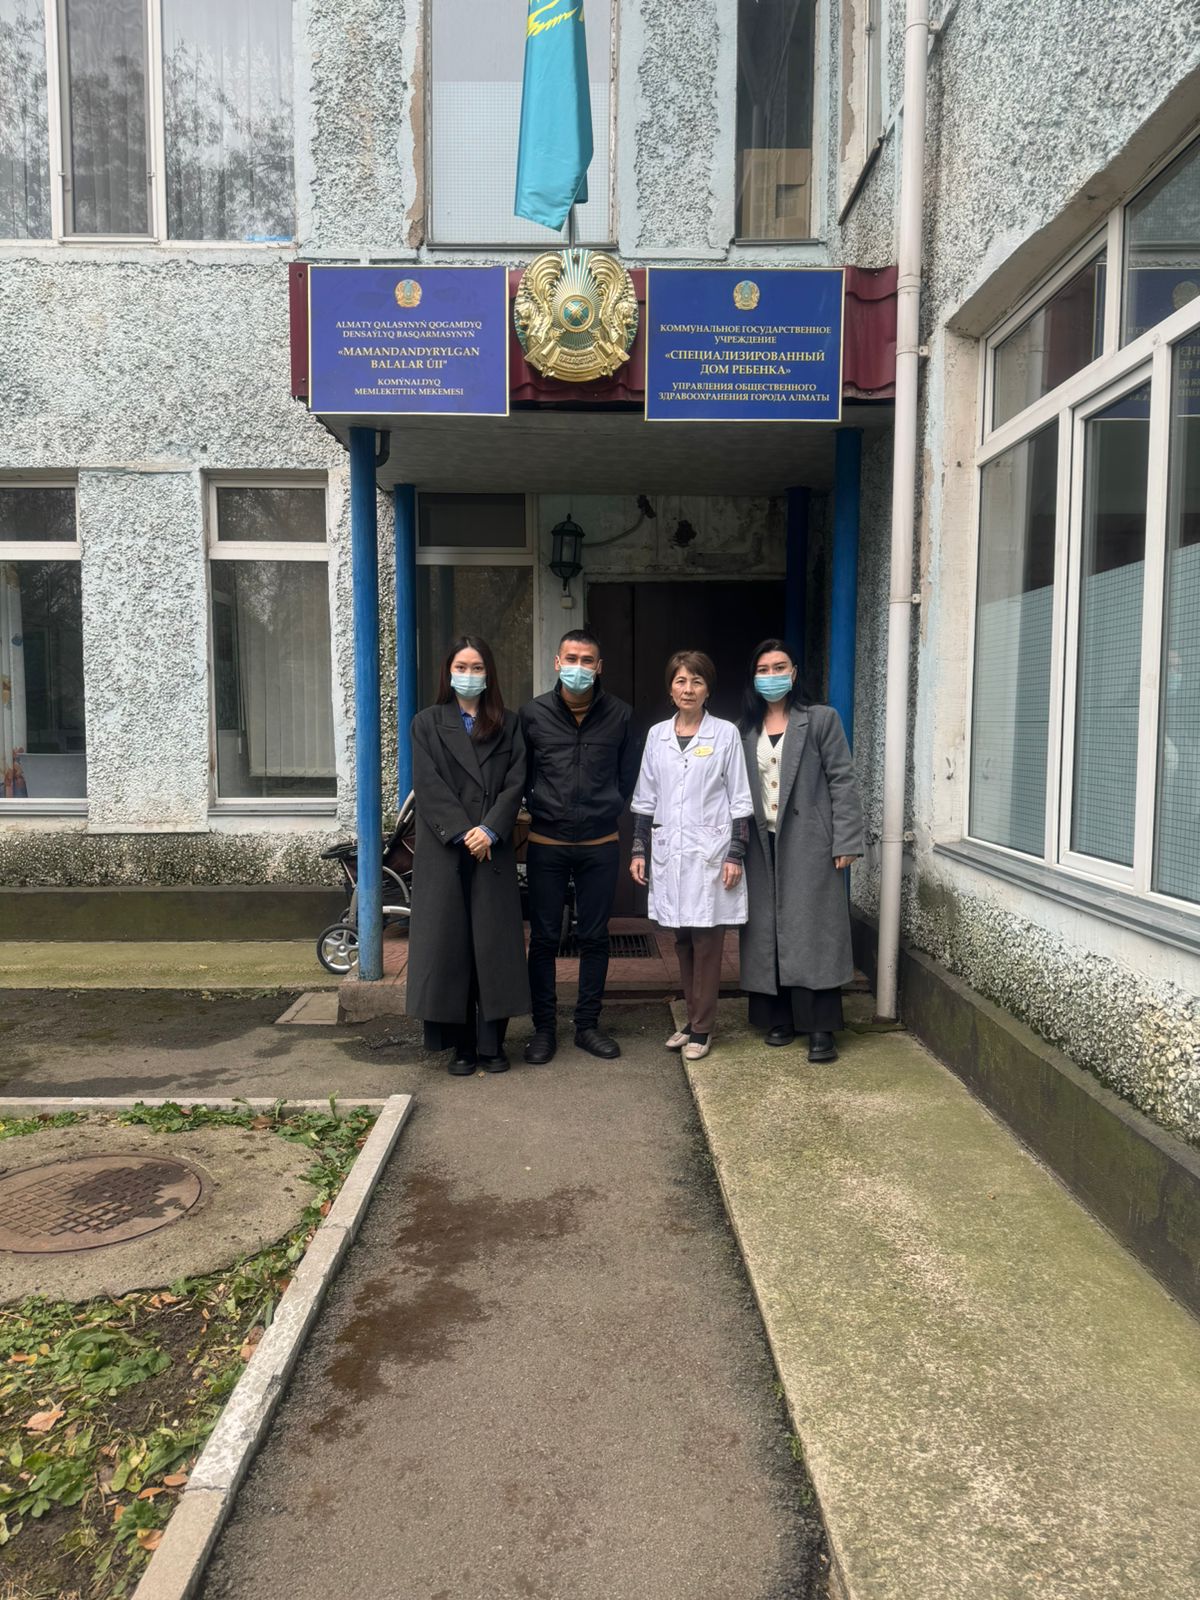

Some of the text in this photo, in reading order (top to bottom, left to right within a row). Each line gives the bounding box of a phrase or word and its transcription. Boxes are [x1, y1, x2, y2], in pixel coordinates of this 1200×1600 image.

[336, 321, 372, 329] ALMATY
[660, 324, 832, 335] КОММУНАЛЬНОЕ ГОСУДАРСТВЕННОЕ
[715, 336, 777, 345] УЧРЕЖДЕНИЕ
[665, 349, 825, 362] «СПЕЦИАЛИЗИРОВАННЫЙ
[371, 360, 423, 369] BALALAR
[700, 364, 791, 375] ДОМ РЕБЕНКА»
[355, 388, 464, 396] MEMLEKETTIK MEKEMESI
[672, 382, 816, 392] УПРАВЛЕНИЯ ОБЩЕСТВЕННОГО
[658, 392, 830, 402] ЗДРАВООХРАНЕНИЯ ГОРОДА АЛМАТЫ
